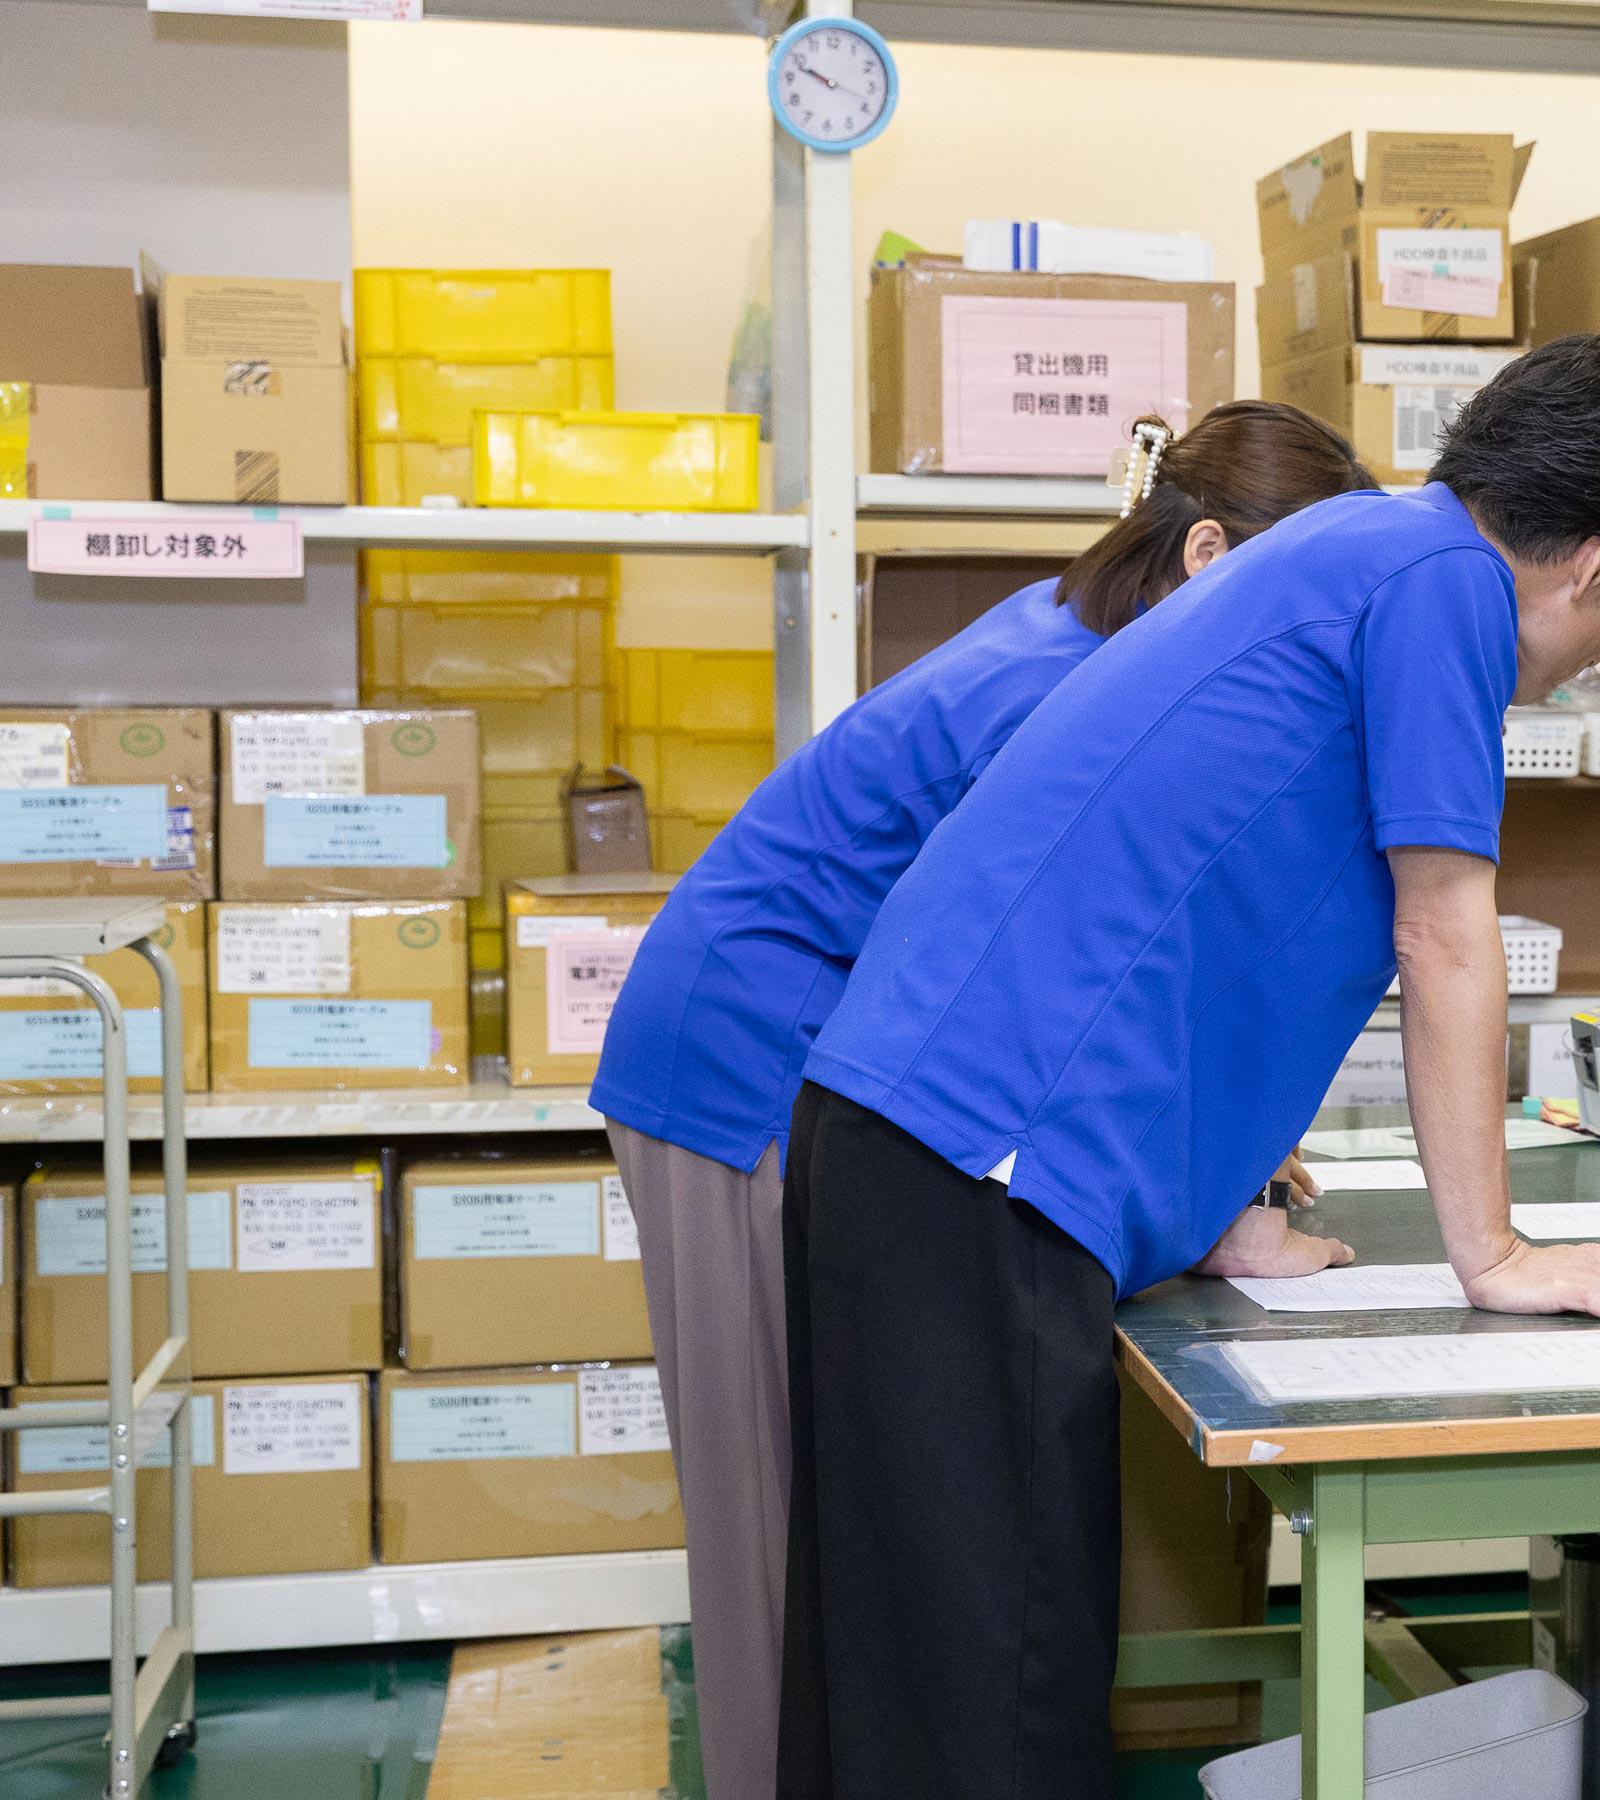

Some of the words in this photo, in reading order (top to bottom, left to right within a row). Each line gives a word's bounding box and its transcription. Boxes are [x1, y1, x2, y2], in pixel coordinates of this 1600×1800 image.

[1013, 352, 1108, 377] 貸出機用
[1013, 391, 1108, 416] 同梱書類
[85, 533, 247, 559] 棚卸し対象外
